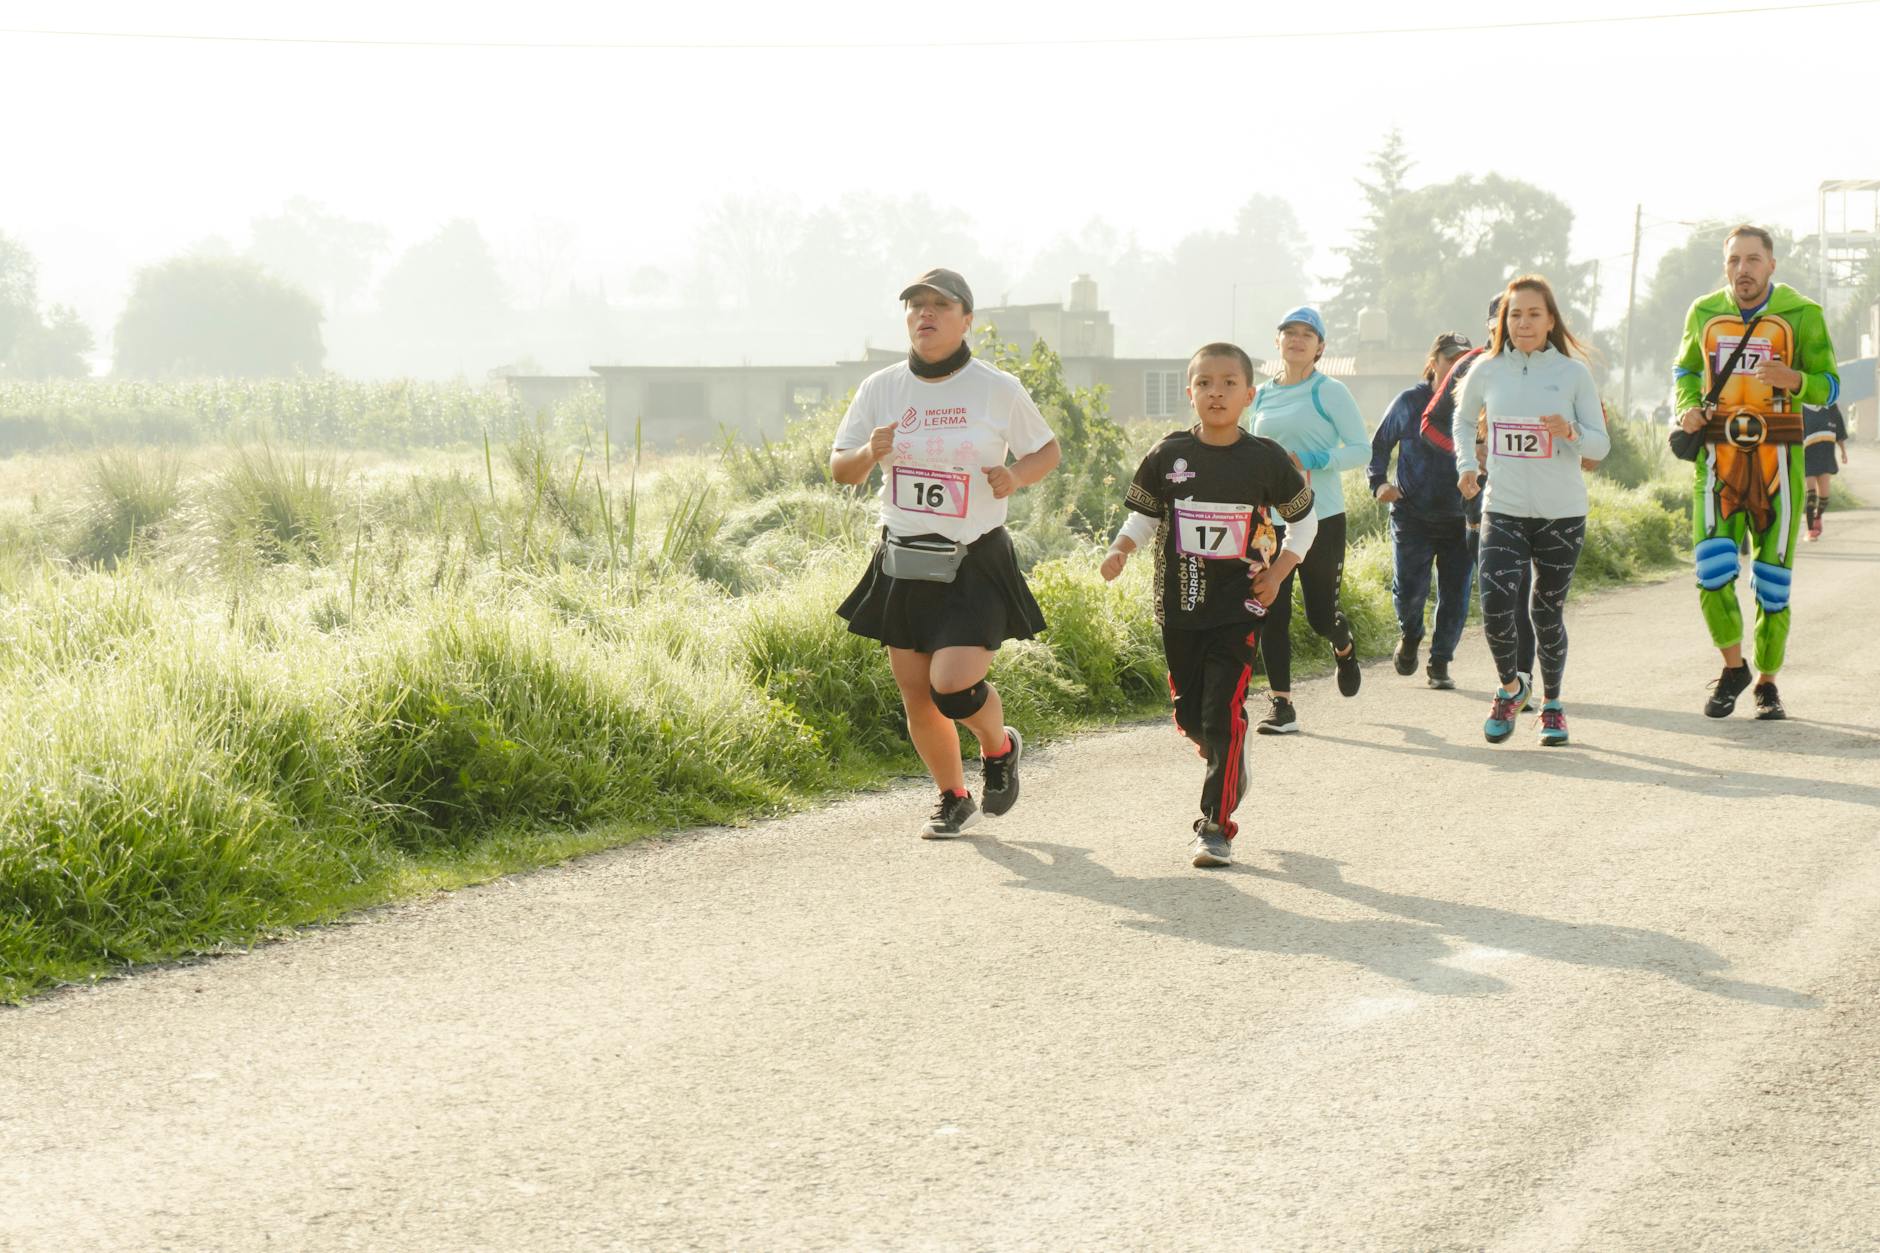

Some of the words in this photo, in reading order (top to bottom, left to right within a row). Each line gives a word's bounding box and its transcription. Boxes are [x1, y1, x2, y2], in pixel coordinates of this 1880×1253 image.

[1730, 352, 1760, 370] 17
[924, 416, 967, 427] LERMA
[925, 407, 967, 417] IMCUFIDE
[1505, 433, 1538, 453] 112
[913, 482, 945, 508] 16
[1195, 526, 1228, 551] 17
[1178, 562, 1189, 611] EDICIÓN
[1187, 556, 1199, 612] CARRERA
[1196, 579, 1207, 604] 3KM
